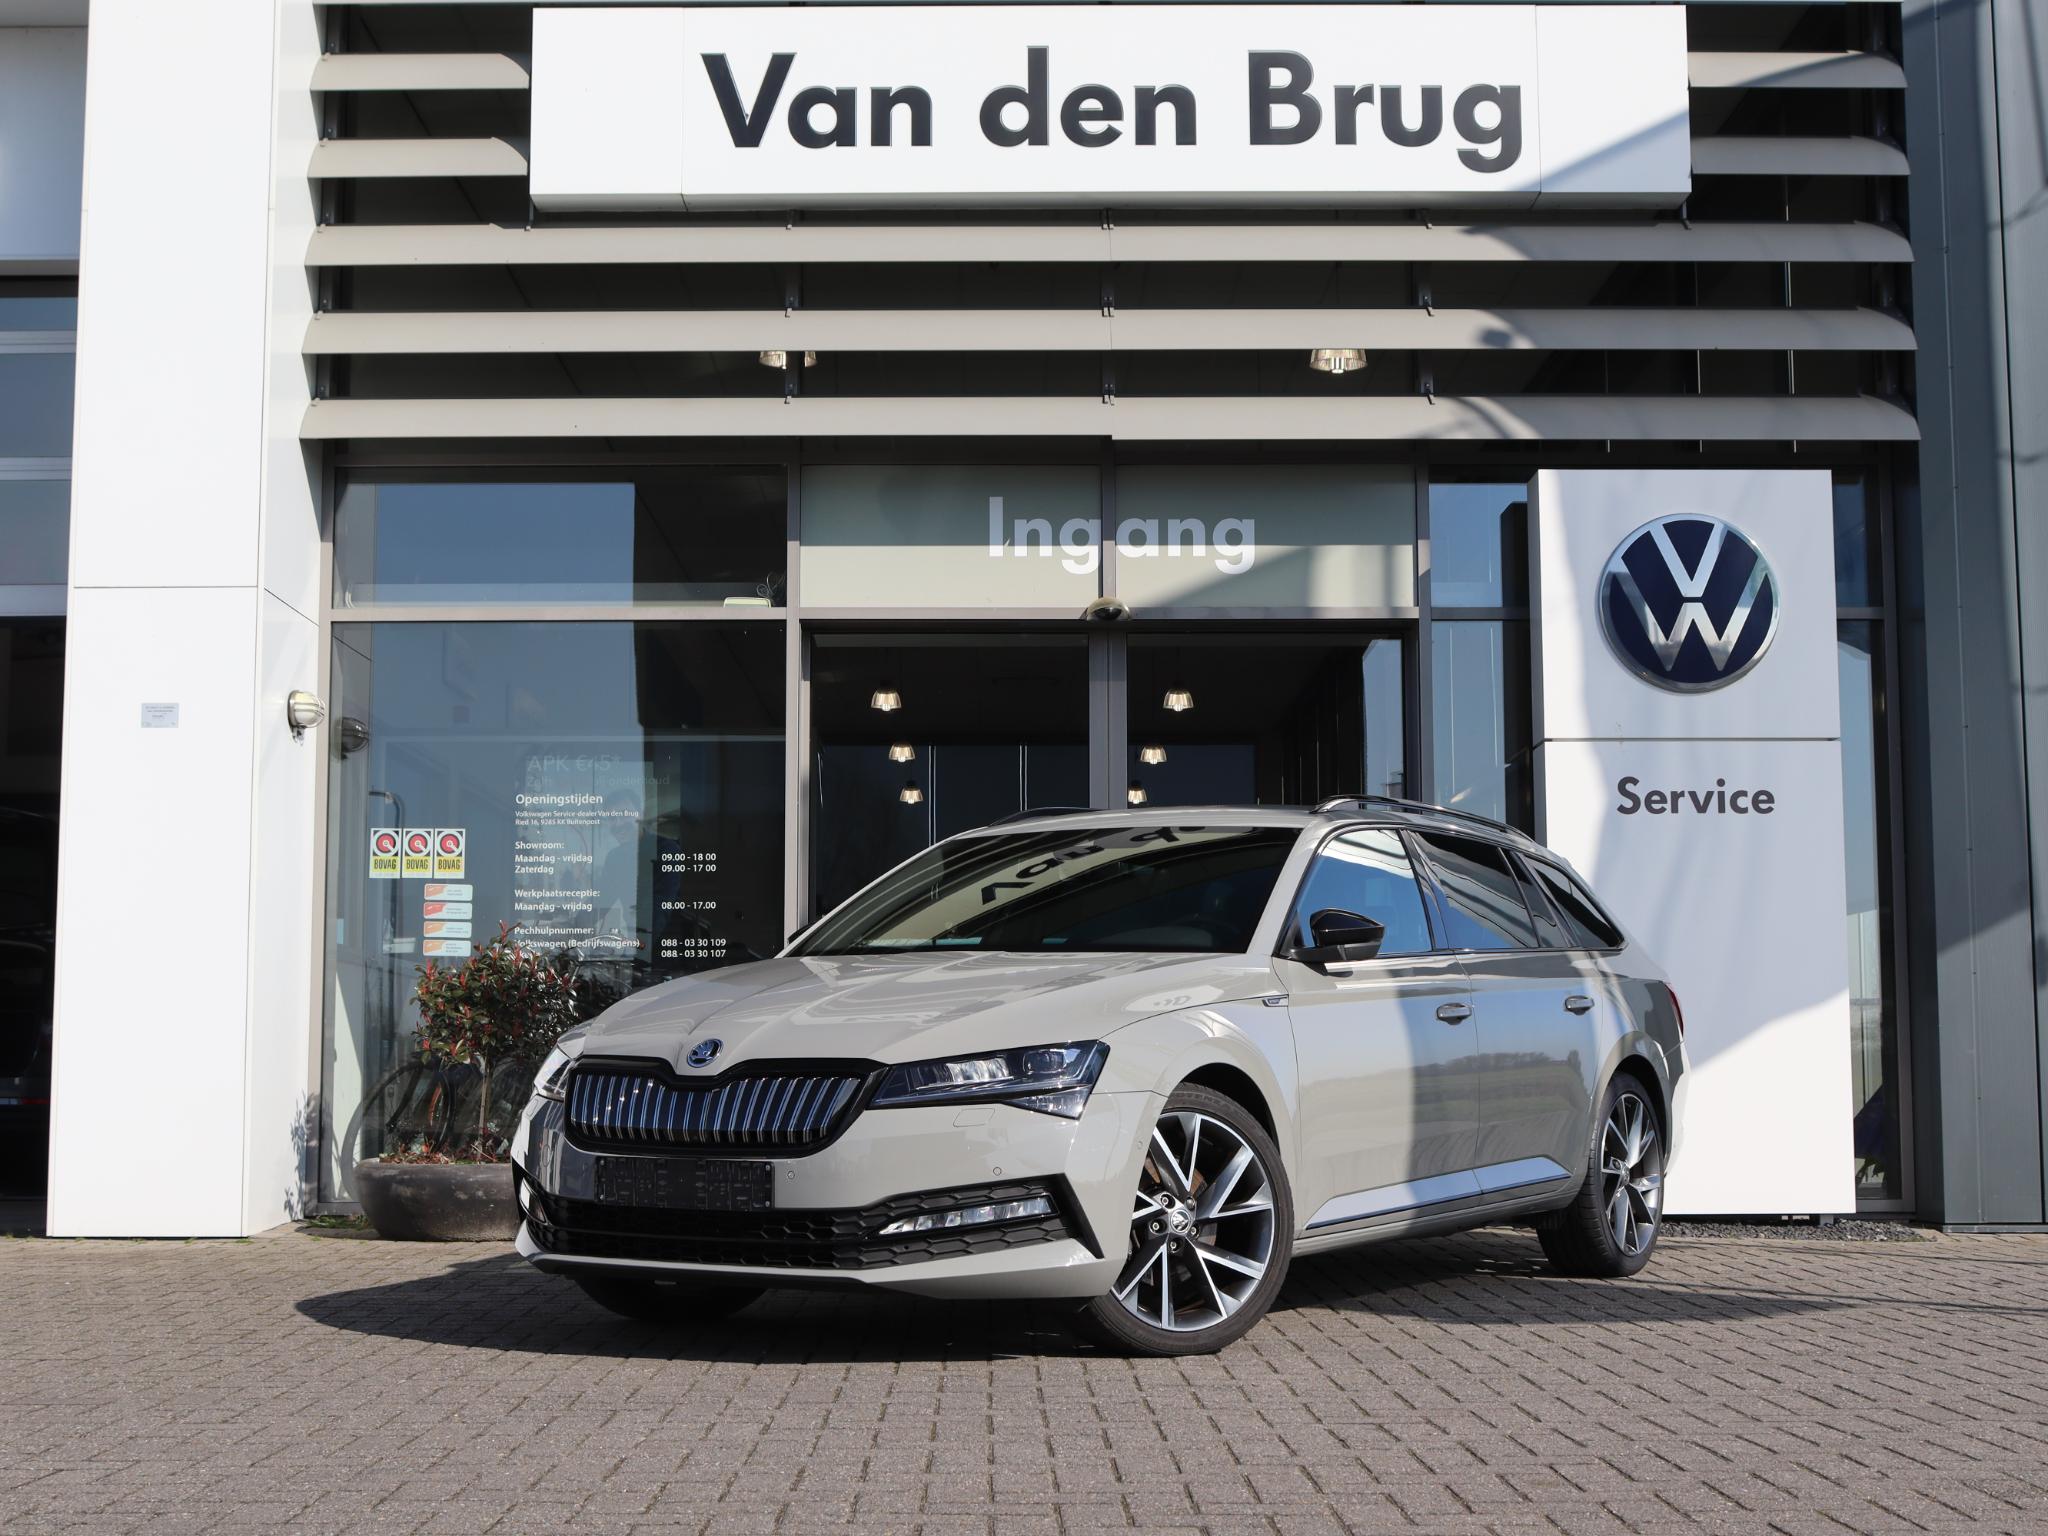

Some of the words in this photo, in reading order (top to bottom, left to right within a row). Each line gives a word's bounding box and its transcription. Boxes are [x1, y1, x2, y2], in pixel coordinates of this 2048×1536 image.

[700, 52, 932, 149] Van
[979, 46, 1197, 149] den
[1248, 51, 1522, 174] Brug
[989, 496, 1255, 575] Ingang
[1604, 518, 1772, 672] VW
[527, 755, 569, 772] APK
[515, 794, 603, 806] Openingstijden
[1617, 776, 1775, 814] Service
[515, 811, 552, 819] Volkswagen
[624, 811, 639, 819] Brug
[515, 841, 565, 850] Showroom:
[515, 854, 556, 864] Maandag
[562, 854, 593, 864] vrijdag
[661, 853, 686, 861] 09.00
[374, 858, 397, 870] BOVAG
[406, 859, 429, 870] BOVAG
[438, 859, 461, 870] BOVAG
[661, 864, 686, 872] 09.00
[515, 865, 555, 875] Zaterdag
[514, 889, 601, 899] Werkplaatsreceptie:
[514, 902, 556, 912] Maandag
[562, 902, 593, 912] vrijdag
[661, 902, 686, 910] 08.00
[693, 902, 717, 910] 17.00
[514, 926, 595, 936] Pechhulpnummer:
[568, 939, 640, 949] (Bedrijfswagens)
[661, 939, 678, 947] 088
[684, 939, 696, 947] 03
[697, 939, 709, 947] 30
[711, 938, 727, 947] 109
[661, 950, 678, 958] 088
[684, 950, 696, 958] 03
[697, 950, 709, 958] 30
[711, 950, 727, 958] 107
